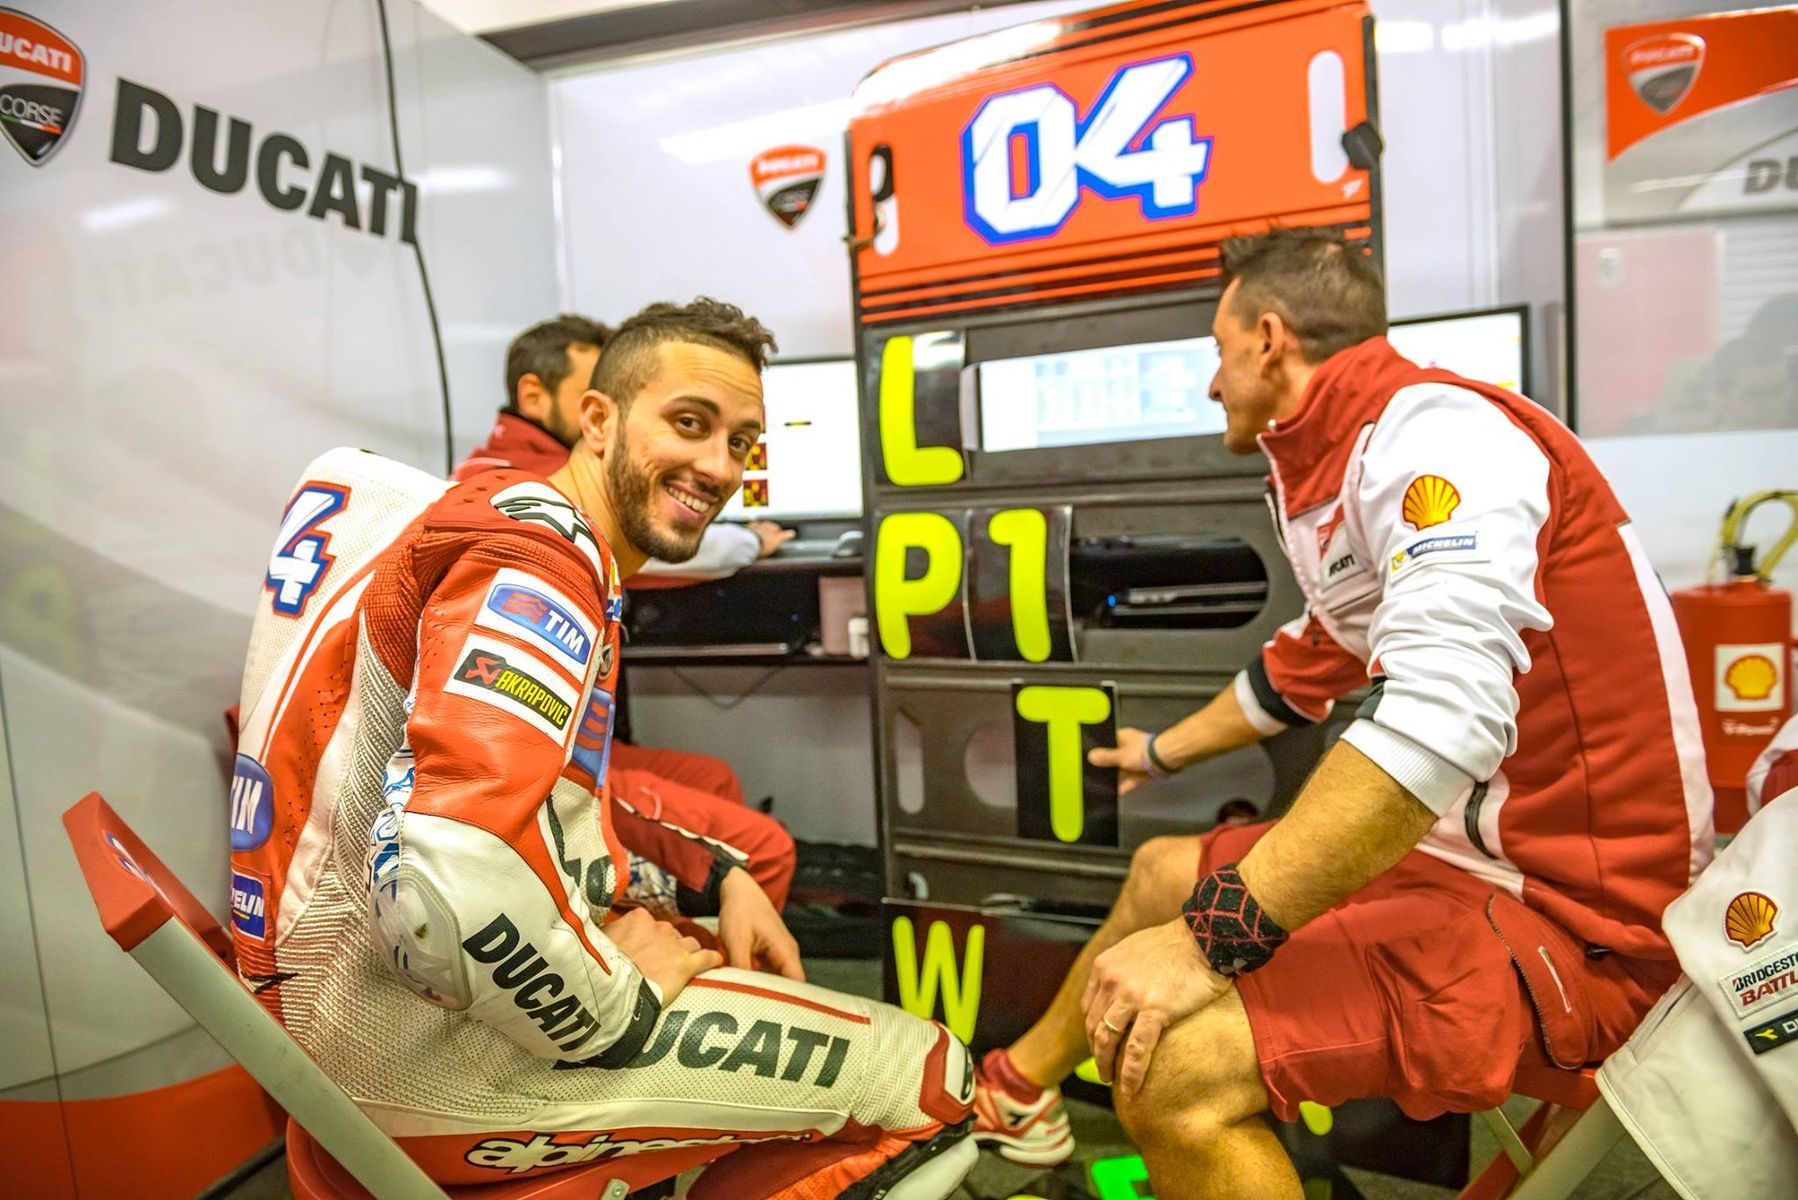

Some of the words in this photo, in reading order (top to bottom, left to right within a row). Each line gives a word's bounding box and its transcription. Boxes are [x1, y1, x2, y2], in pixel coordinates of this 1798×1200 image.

[0, 94, 63, 128] CORSE
[109, 77, 419, 245] DUCATI
[959, 52, 1214, 246] 04
[879, 335, 964, 487] L
[264, 480, 352, 619] 4
[1412, 537, 1475, 555] MICHELIN
[543, 610, 588, 656] TIM
[231, 775, 263, 834] IM
[1015, 685, 1111, 843] T
[462, 912, 602, 1052] DUCATI
[892, 915, 986, 1046] W
[1732, 951, 1798, 993] BRIDGEST
[552, 1009, 850, 1088] UCATI
